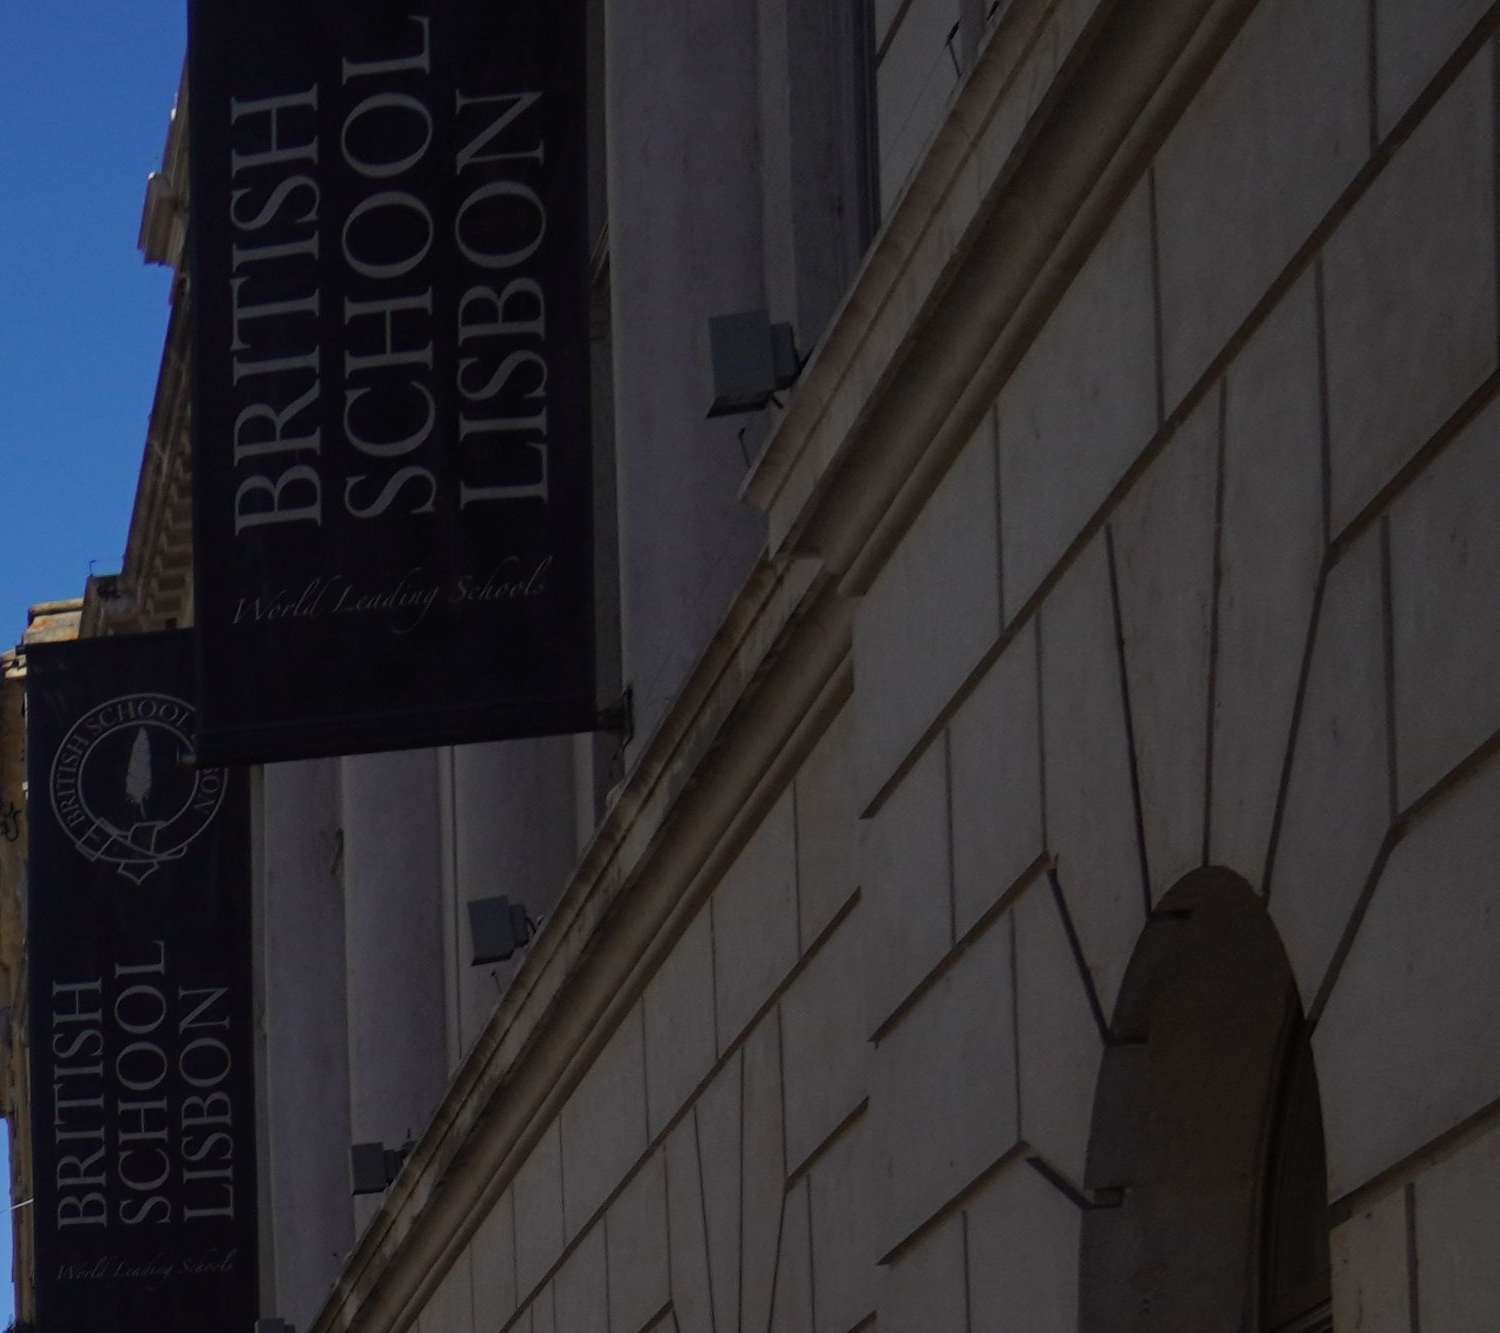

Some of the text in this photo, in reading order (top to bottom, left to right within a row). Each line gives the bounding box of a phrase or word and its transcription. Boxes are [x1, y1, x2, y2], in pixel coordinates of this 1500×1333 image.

[230, 83, 321, 536] BRITISH
[341, 16, 435, 520] SCHOOL
[455, 89, 548, 510] LISBON
[232, 574, 341, 624] World
[332, 566, 439, 635] Leading
[56, 737, 89, 827] BRITISH
[51, 977, 108, 1230] BRITISH
[115, 940, 172, 1225] SCHOOL
[180, 985, 235, 1220] LISBON
